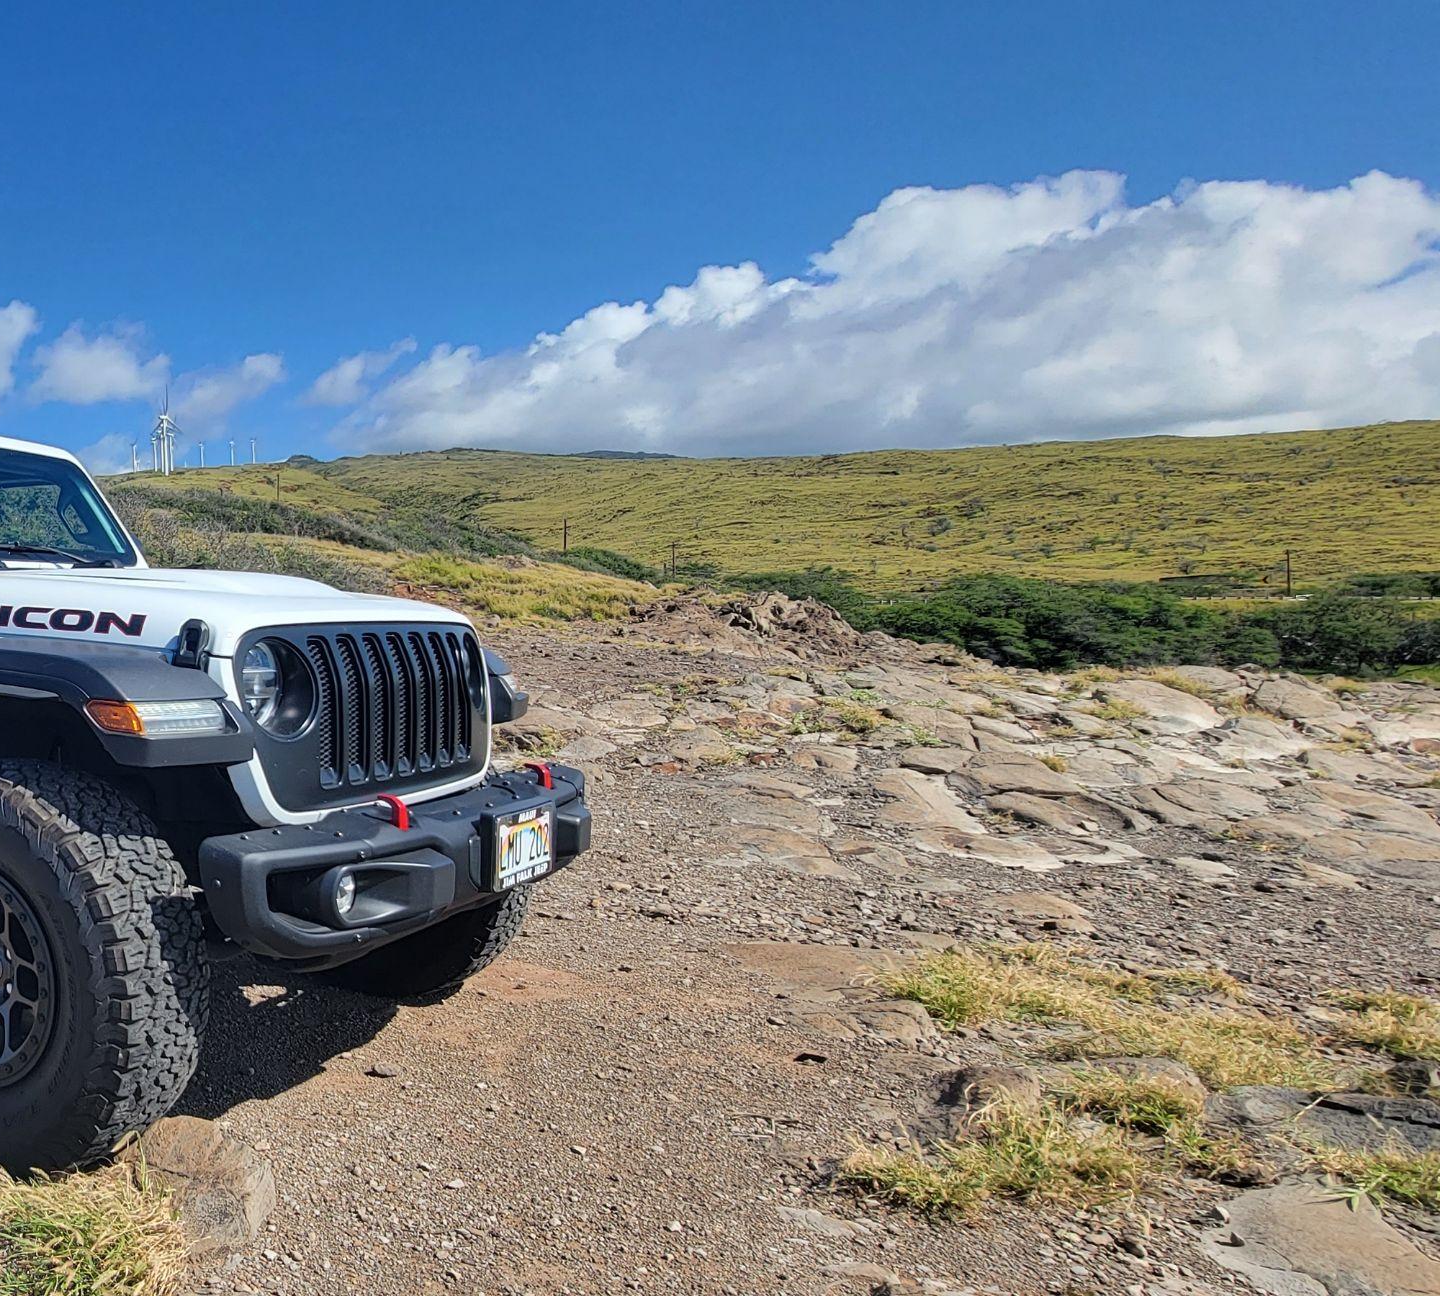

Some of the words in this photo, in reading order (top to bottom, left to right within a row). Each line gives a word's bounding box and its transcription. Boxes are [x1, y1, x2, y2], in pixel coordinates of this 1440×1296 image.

[518, 809, 537, 823] MAUI
[500, 830, 522, 871] LMU
[529, 823, 549, 861] 202
[503, 877, 516, 889] JIM
[516, 869, 533, 882] FALK
[534, 862, 548, 877] JEEP
